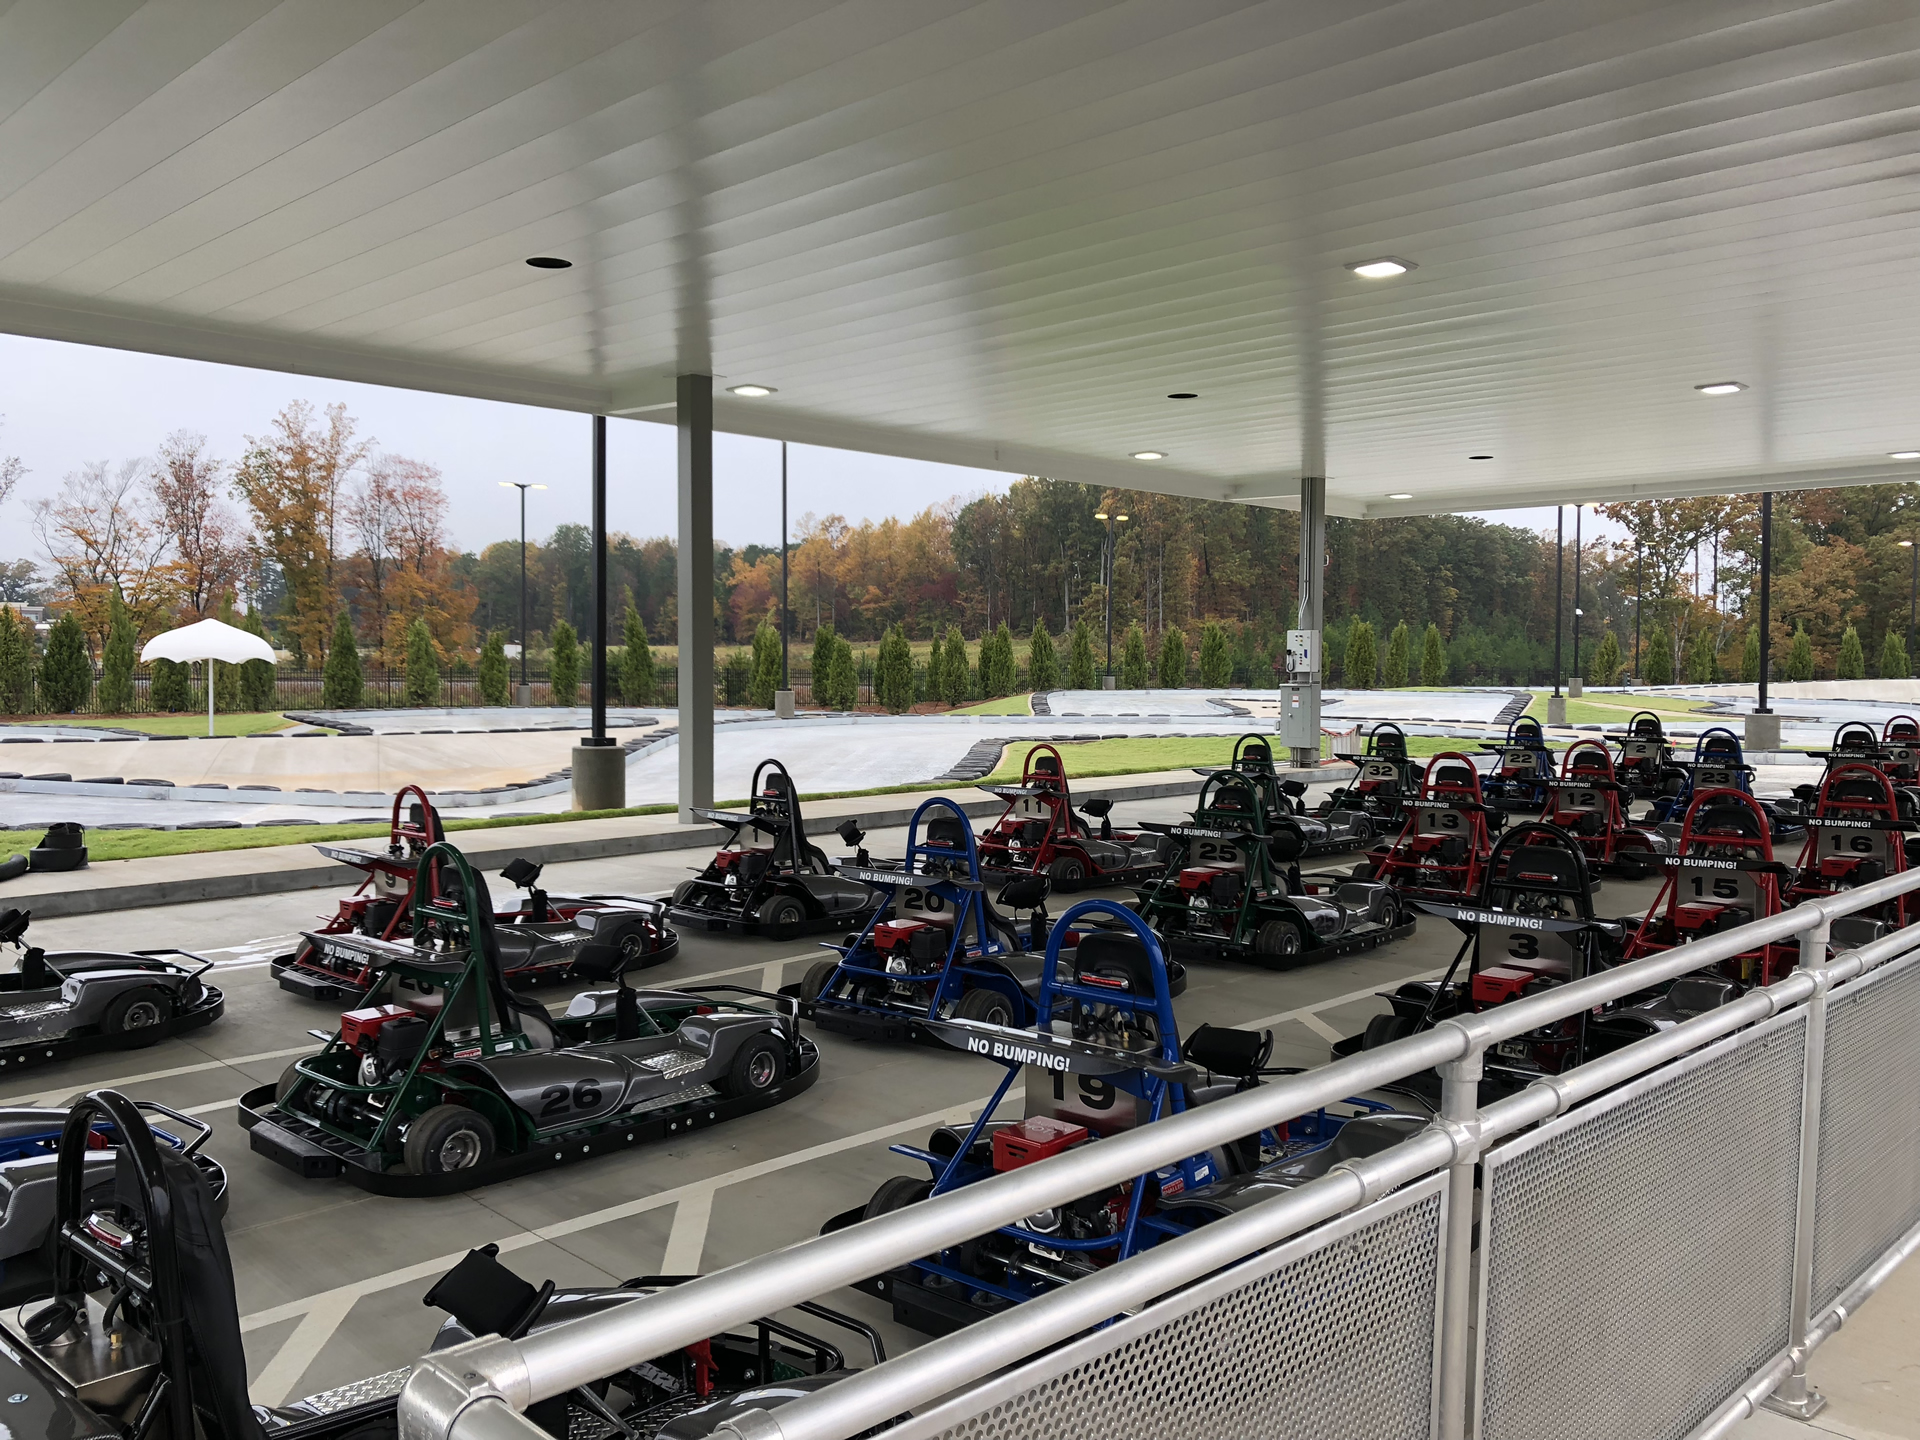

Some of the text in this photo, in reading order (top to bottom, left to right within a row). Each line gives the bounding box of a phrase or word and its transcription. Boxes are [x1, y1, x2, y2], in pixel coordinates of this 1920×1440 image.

[1636, 744, 1647, 754] 2
[1509, 753, 1532, 763] 22
[1369, 765, 1393, 777] 32
[1701, 772, 1730, 784] 23
[1023, 798, 1042, 813] 11
[1414, 800, 1450, 809] BUMPING!
[1567, 792, 1596, 806] 12
[1427, 812, 1459, 829] 13
[1808, 818, 1871, 829] NO BUMPING!
[1183, 828, 1222, 838] BUMPING!
[1831, 834, 1873, 853] 16
[1199, 842, 1238, 863] 25
[1665, 857, 1737, 870] NO BUMPING!
[384, 871, 397, 889] 9
[860, 871, 914, 886] NO BUMPING!
[1690, 876, 1740, 899] 15
[904, 887, 945, 913] 20
[1457, 910, 1543, 930] NO BUMPING!
[324, 943, 370, 965] NO BUMPING!
[1508, 933, 1540, 960] 3
[967, 1036, 1071, 1072] NO BUMPING!
[540, 1077, 603, 1118] 26
[1047, 1068, 1117, 1111] 19
